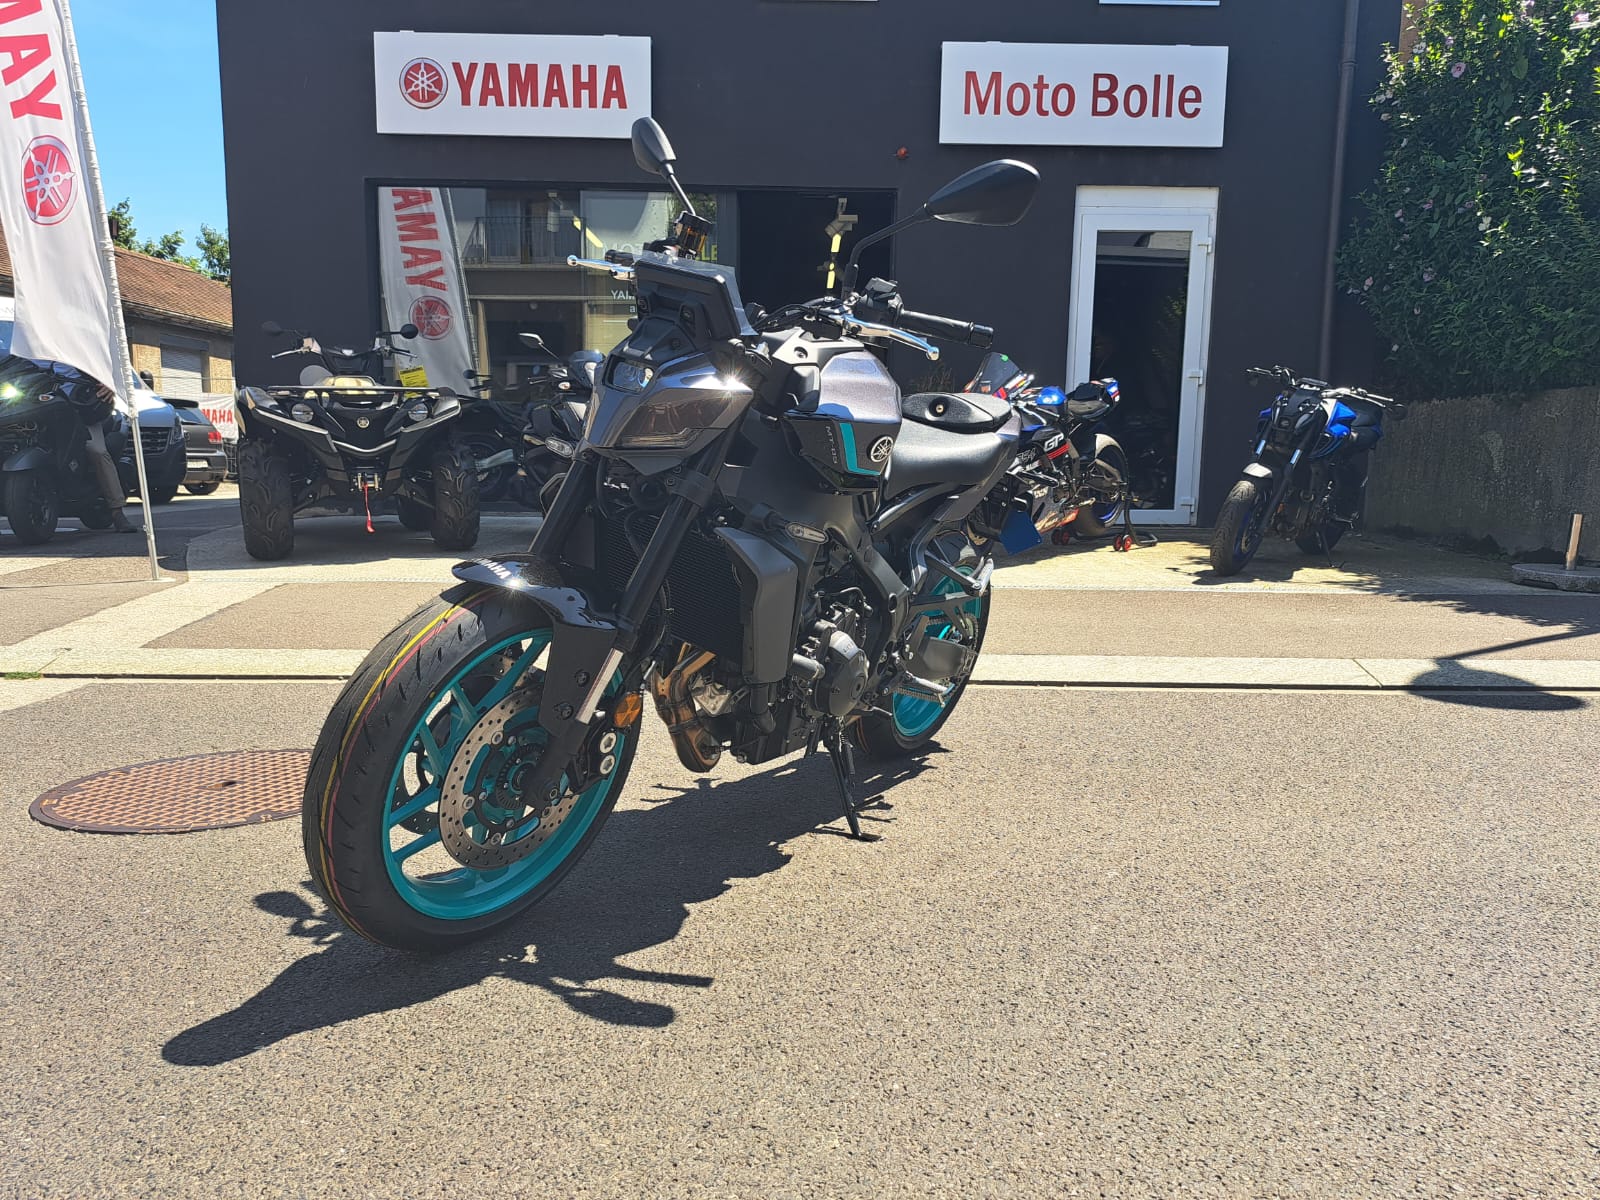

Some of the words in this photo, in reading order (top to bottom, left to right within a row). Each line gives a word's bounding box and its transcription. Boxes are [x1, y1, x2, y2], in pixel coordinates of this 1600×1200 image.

[452, 62, 628, 109] YAMAHA
[964, 71, 1076, 117] Moto
[1091, 73, 1202, 119] Bolle
